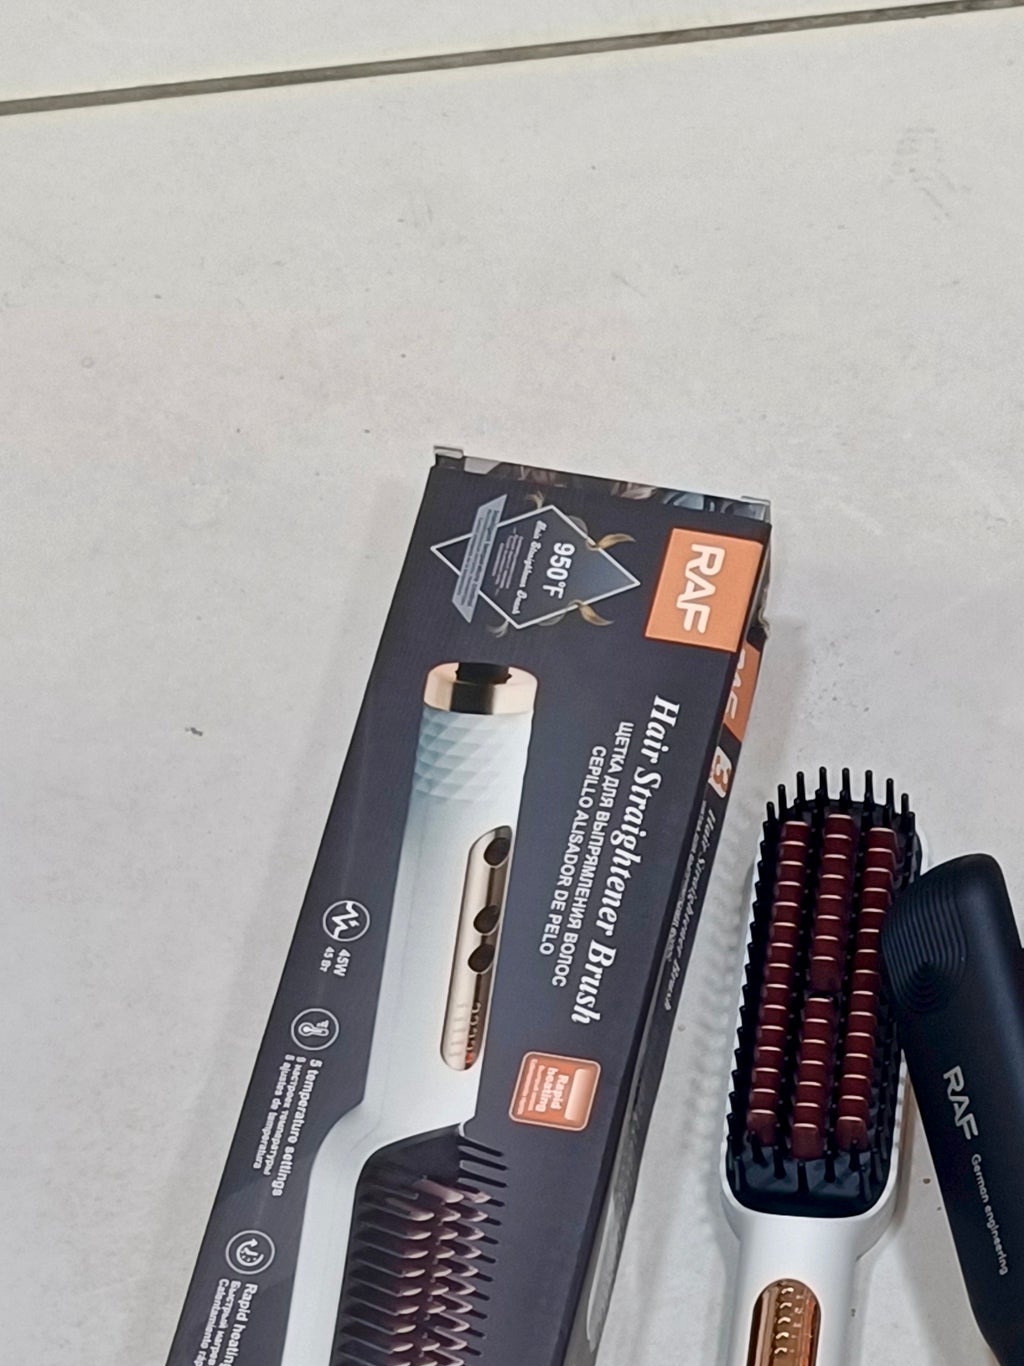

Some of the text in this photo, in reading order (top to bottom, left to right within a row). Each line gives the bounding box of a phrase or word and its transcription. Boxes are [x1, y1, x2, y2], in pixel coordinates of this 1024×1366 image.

[542, 542, 575, 598] 950°F
[676, 543, 725, 633] RAF
[538, 745, 606, 955] CEPILLO ALISADOR DE PELO
[551, 721, 634, 987] ЩЕТКА ДЛЯ ВЫПРЯМЛЕНИЯ ВОЛОС
[570, 695, 679, 1023] Hair Straightener Brush
[323, 946, 335, 958] 45
[332, 948, 350, 976] 45W
[270, 1058, 323, 1196] 5 temperature settings
[942, 1065, 978, 1140] RAF
[970, 1153, 1008, 1275] German engineering
[235, 1282, 258, 1321] Rapid
